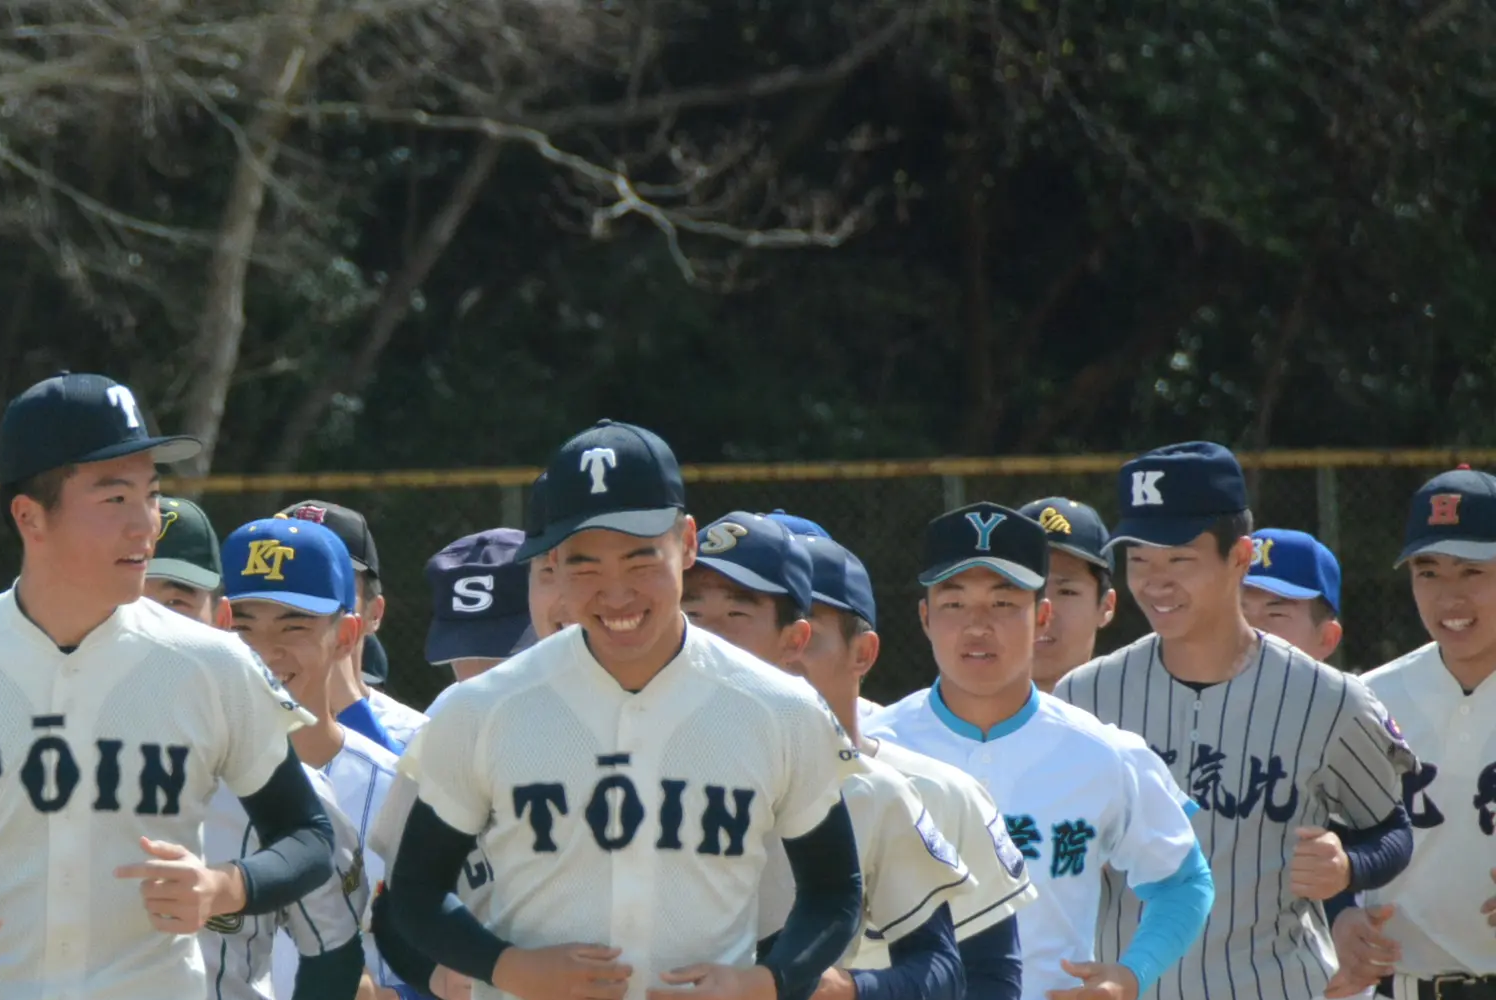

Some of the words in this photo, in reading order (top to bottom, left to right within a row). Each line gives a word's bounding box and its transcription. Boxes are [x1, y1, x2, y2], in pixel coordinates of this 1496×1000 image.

[107, 384, 141, 428] T
[579, 447, 616, 494] T
[1131, 470, 1165, 506] K
[700, 522, 748, 553] S
[964, 512, 1006, 551] Y
[241, 539, 295, 580] KT
[452, 575, 494, 612] S
